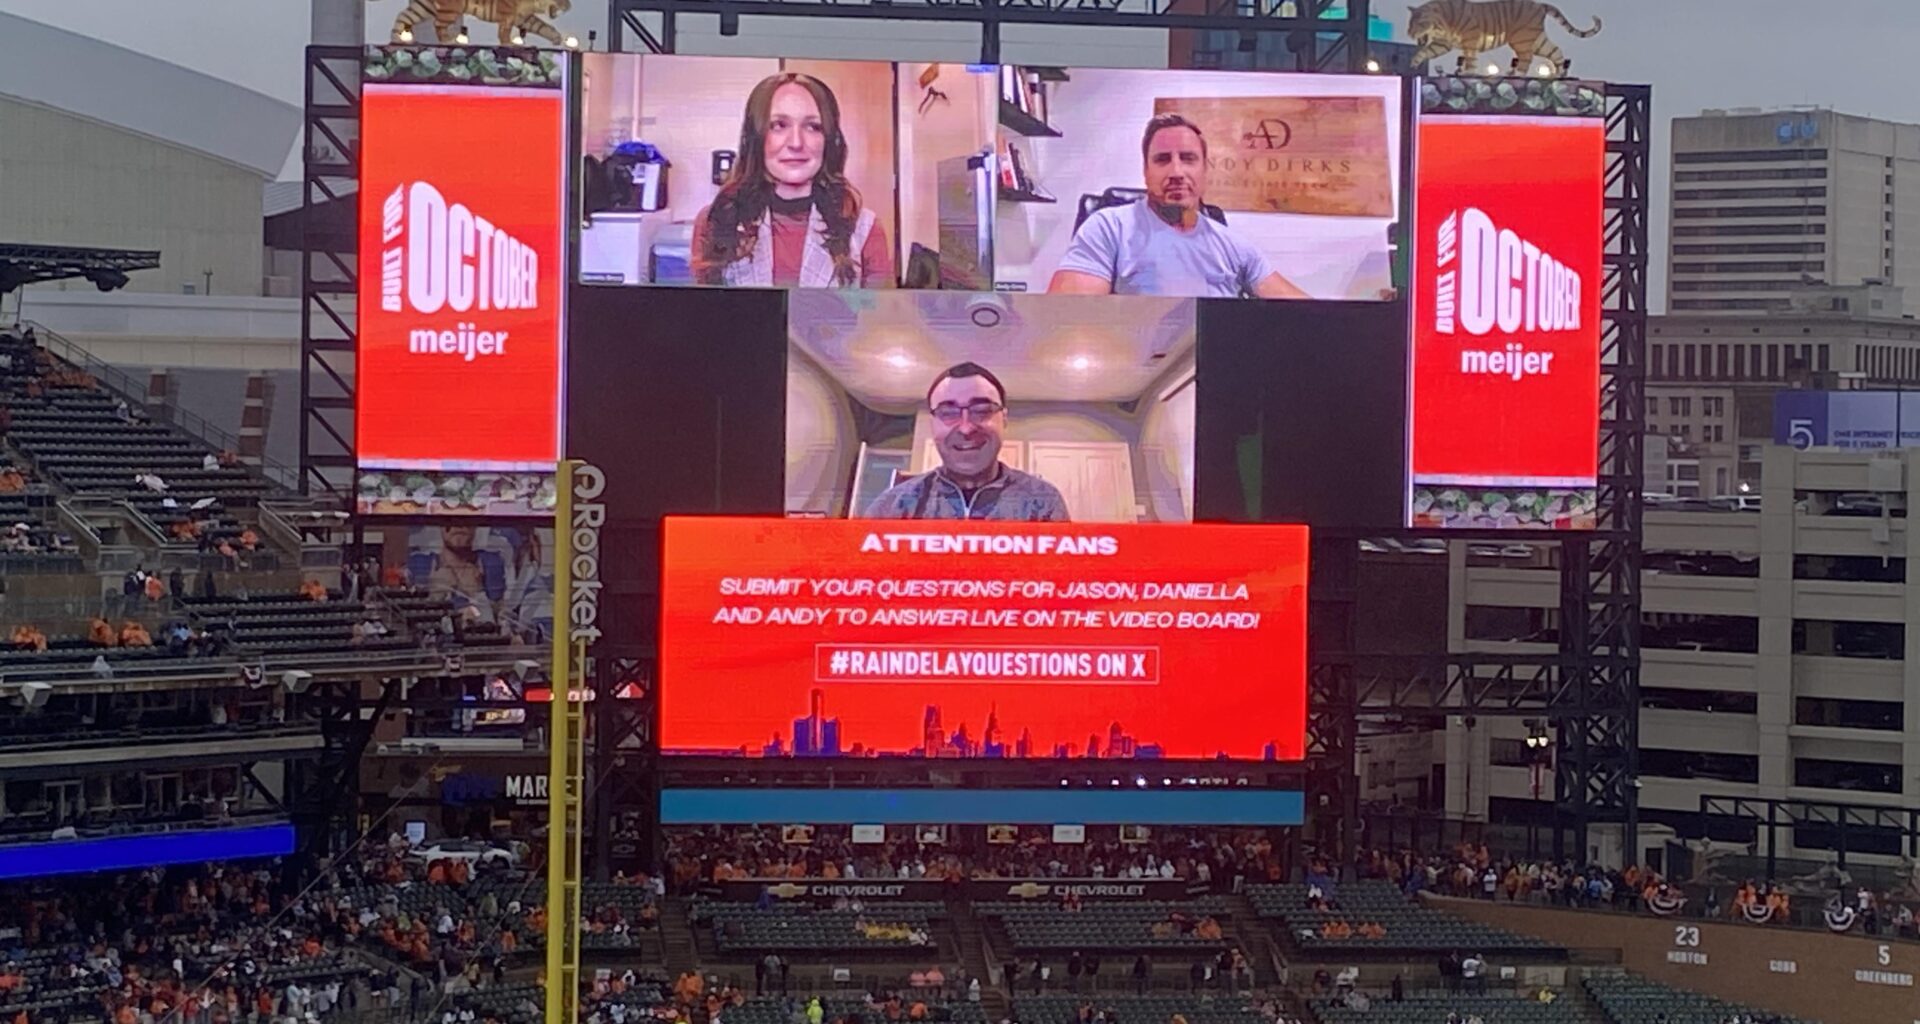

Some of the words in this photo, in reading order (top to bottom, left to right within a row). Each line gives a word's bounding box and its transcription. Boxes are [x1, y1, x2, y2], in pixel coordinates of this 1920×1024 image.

[1206, 158, 1251, 172] NDY
[1267, 158, 1352, 173] DIRKS
[382, 182, 404, 245] FOR
[408, 180, 538, 314] OCTOBER
[1437, 208, 1457, 268] FOR
[381, 246, 402, 313] BUILT
[1460, 207, 1581, 336] OCTOBER
[1435, 270, 1456, 334] BUILT
[409, 322, 509, 361] meijer
[1461, 342, 1554, 381] meijer
[1790, 419, 1814, 452] 5
[860, 533, 1034, 555] ATTENTION
[1037, 536, 1119, 555] FANS
[571, 503, 605, 643] Rocket
[719, 578, 805, 596] SUBMIT
[809, 578, 875, 597] YOUR
[876, 579, 1006, 599] QUESTIONS
[1008, 581, 1055, 598] FOR
[1056, 582, 1140, 601] JASON,
[1142, 583, 1250, 600] DANIELLA
[712, 607, 763, 624] AND
[764, 607, 831, 625] ANDY
[836, 608, 868, 625] TO
[869, 608, 968, 626] ANSWER
[970, 609, 1020, 627] LIVE
[1022, 610, 1057, 627] ON
[1061, 610, 1106, 628] THE
[1108, 611, 1174, 629] VIDEO
[1176, 612, 1262, 629] BOARD!
[829, 650, 1092, 677] #RAINDELAYQUESTIONS
[1097, 653, 1127, 677] ON
[1131, 654, 1147, 677] X
[812, 884, 905, 896] CHEVROLET
[1053, 884, 1146, 896] CHEVROLET
[1675, 926, 1700, 947] 23
[1878, 944, 1891, 965] 5
